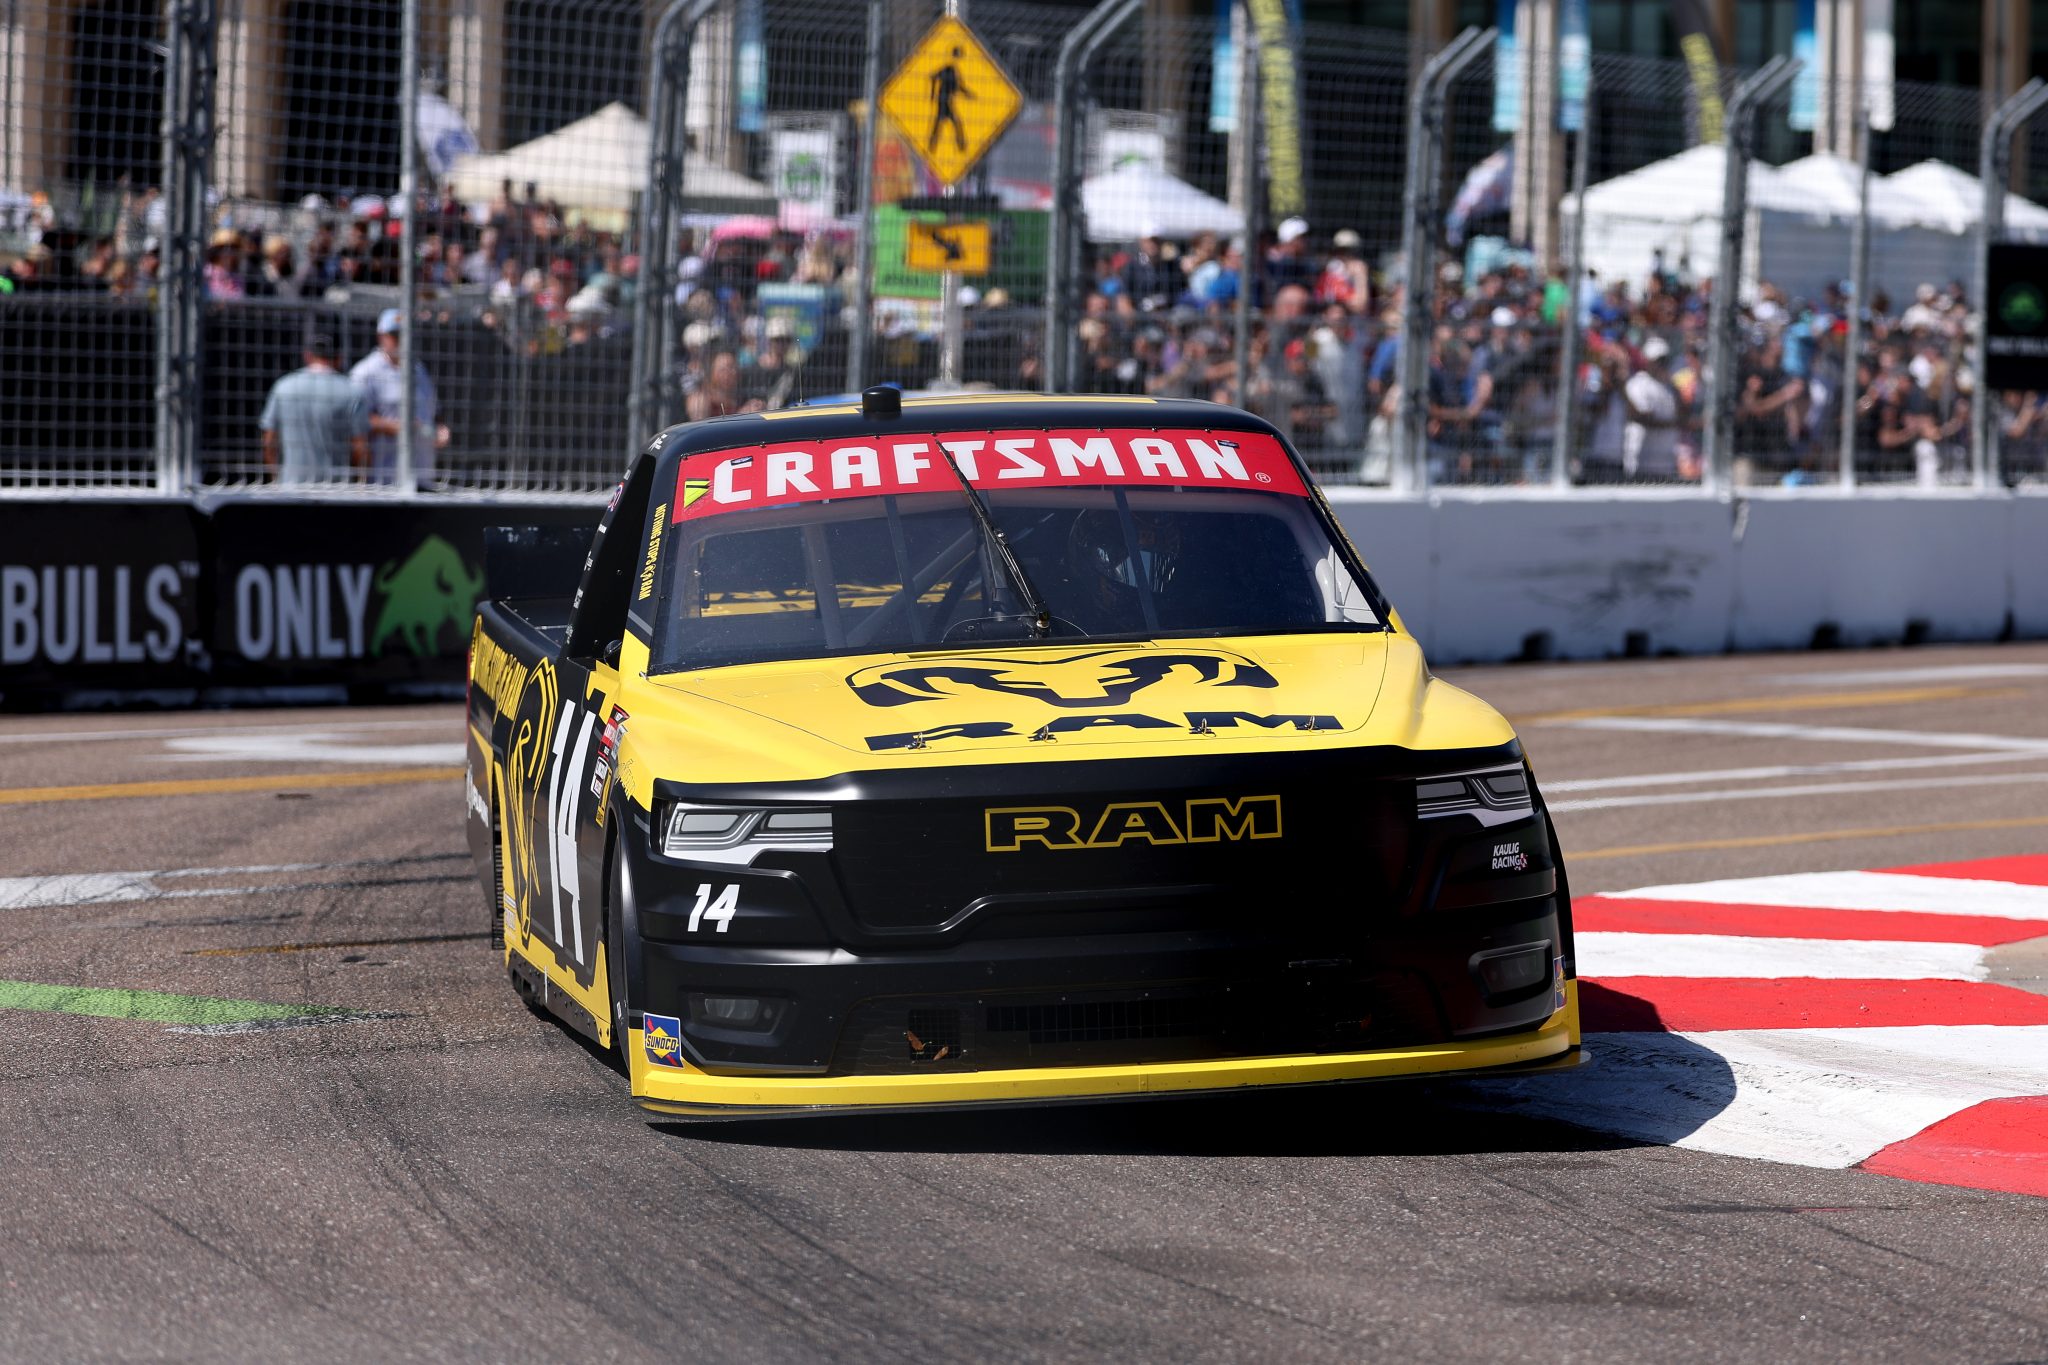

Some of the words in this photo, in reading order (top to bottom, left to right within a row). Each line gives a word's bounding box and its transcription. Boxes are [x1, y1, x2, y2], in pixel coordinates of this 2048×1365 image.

[236, 563, 373, 661] ONLY
[864, 711, 1344, 751] RAM
[548, 698, 597, 966] 14
[985, 795, 1283, 852] RAM
[1492, 855, 1521, 870] RACING
[1493, 842, 1520, 857] KAULIG
[688, 884, 740, 932] 14
[647, 1035, 677, 1051] SUNOCO
